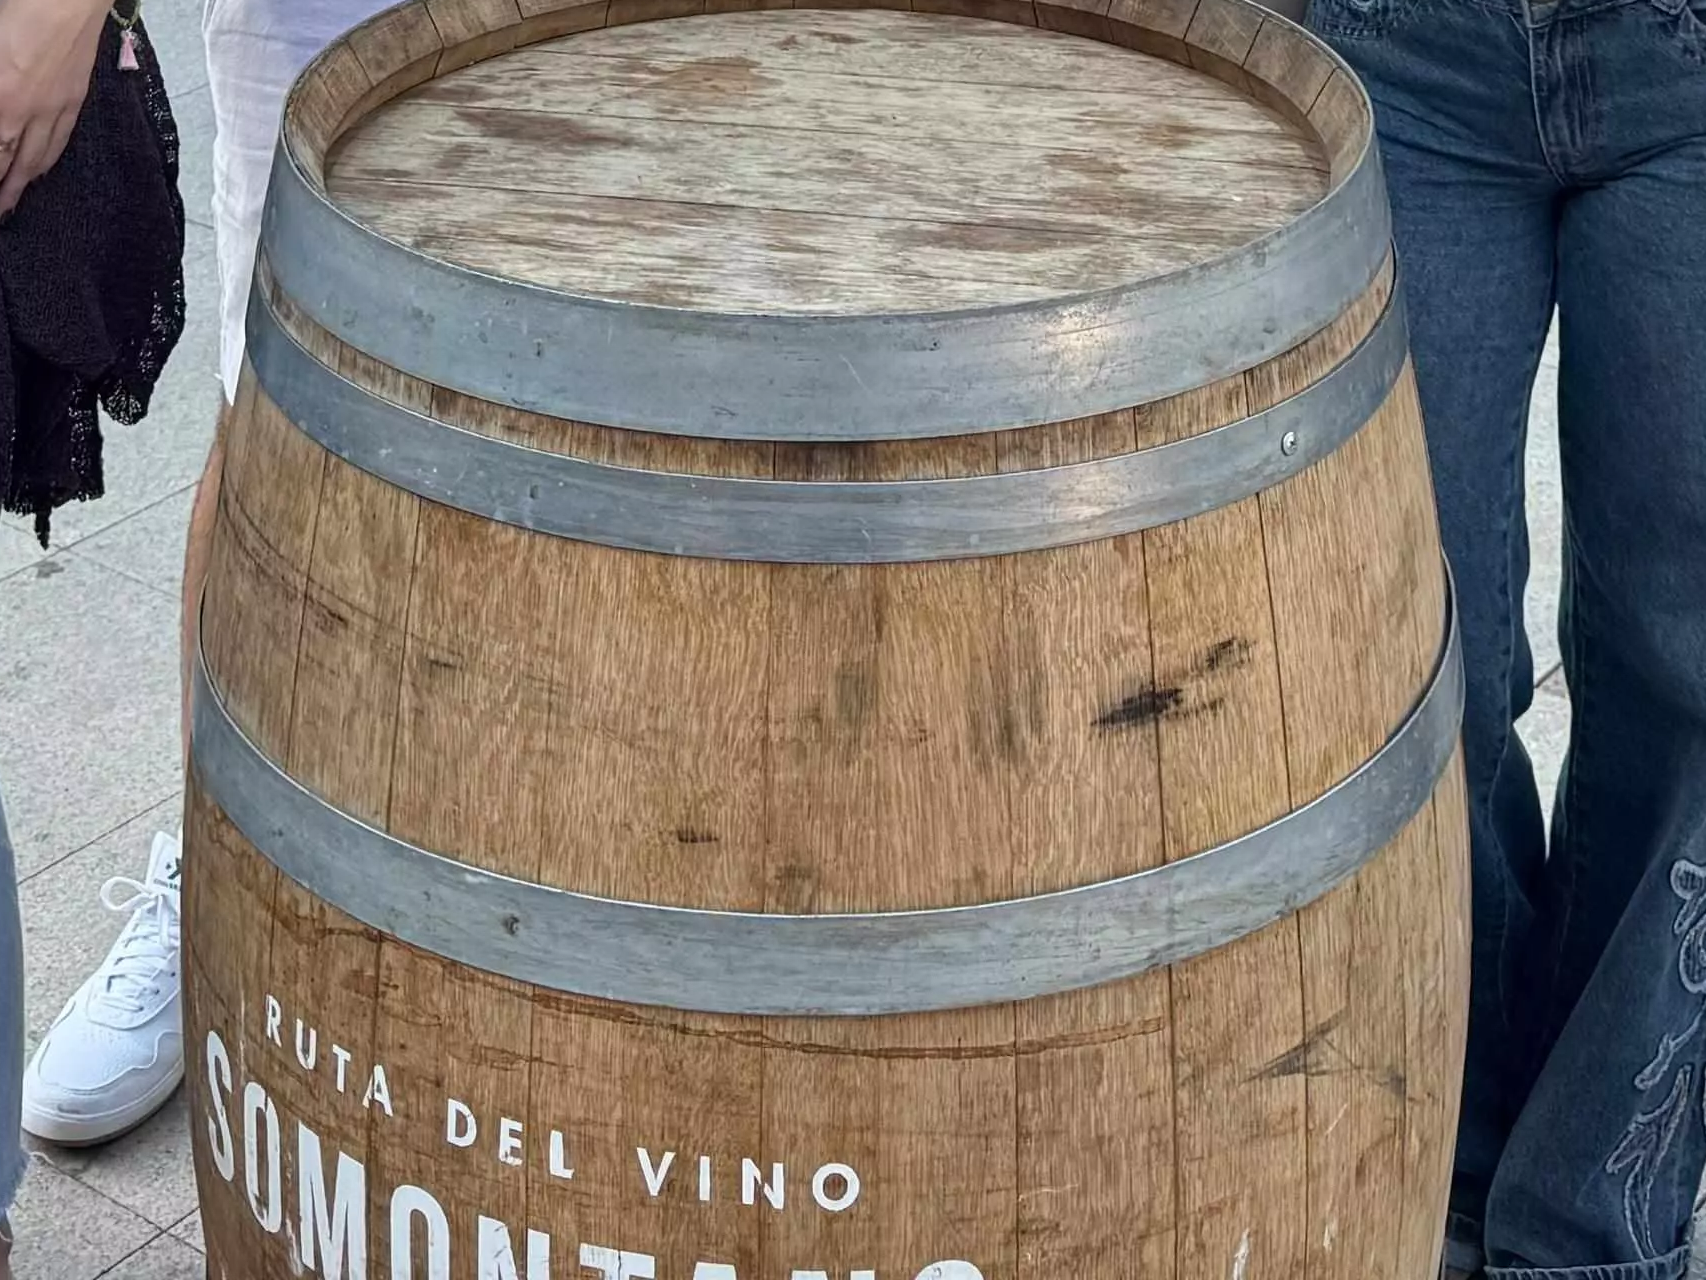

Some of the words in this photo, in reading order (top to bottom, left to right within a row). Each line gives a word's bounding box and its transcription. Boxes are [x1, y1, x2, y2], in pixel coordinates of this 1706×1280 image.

[265, 993, 394, 1117] RUTA
[446, 1097, 575, 1180] DEL
[636, 1146, 861, 1212] VINO
